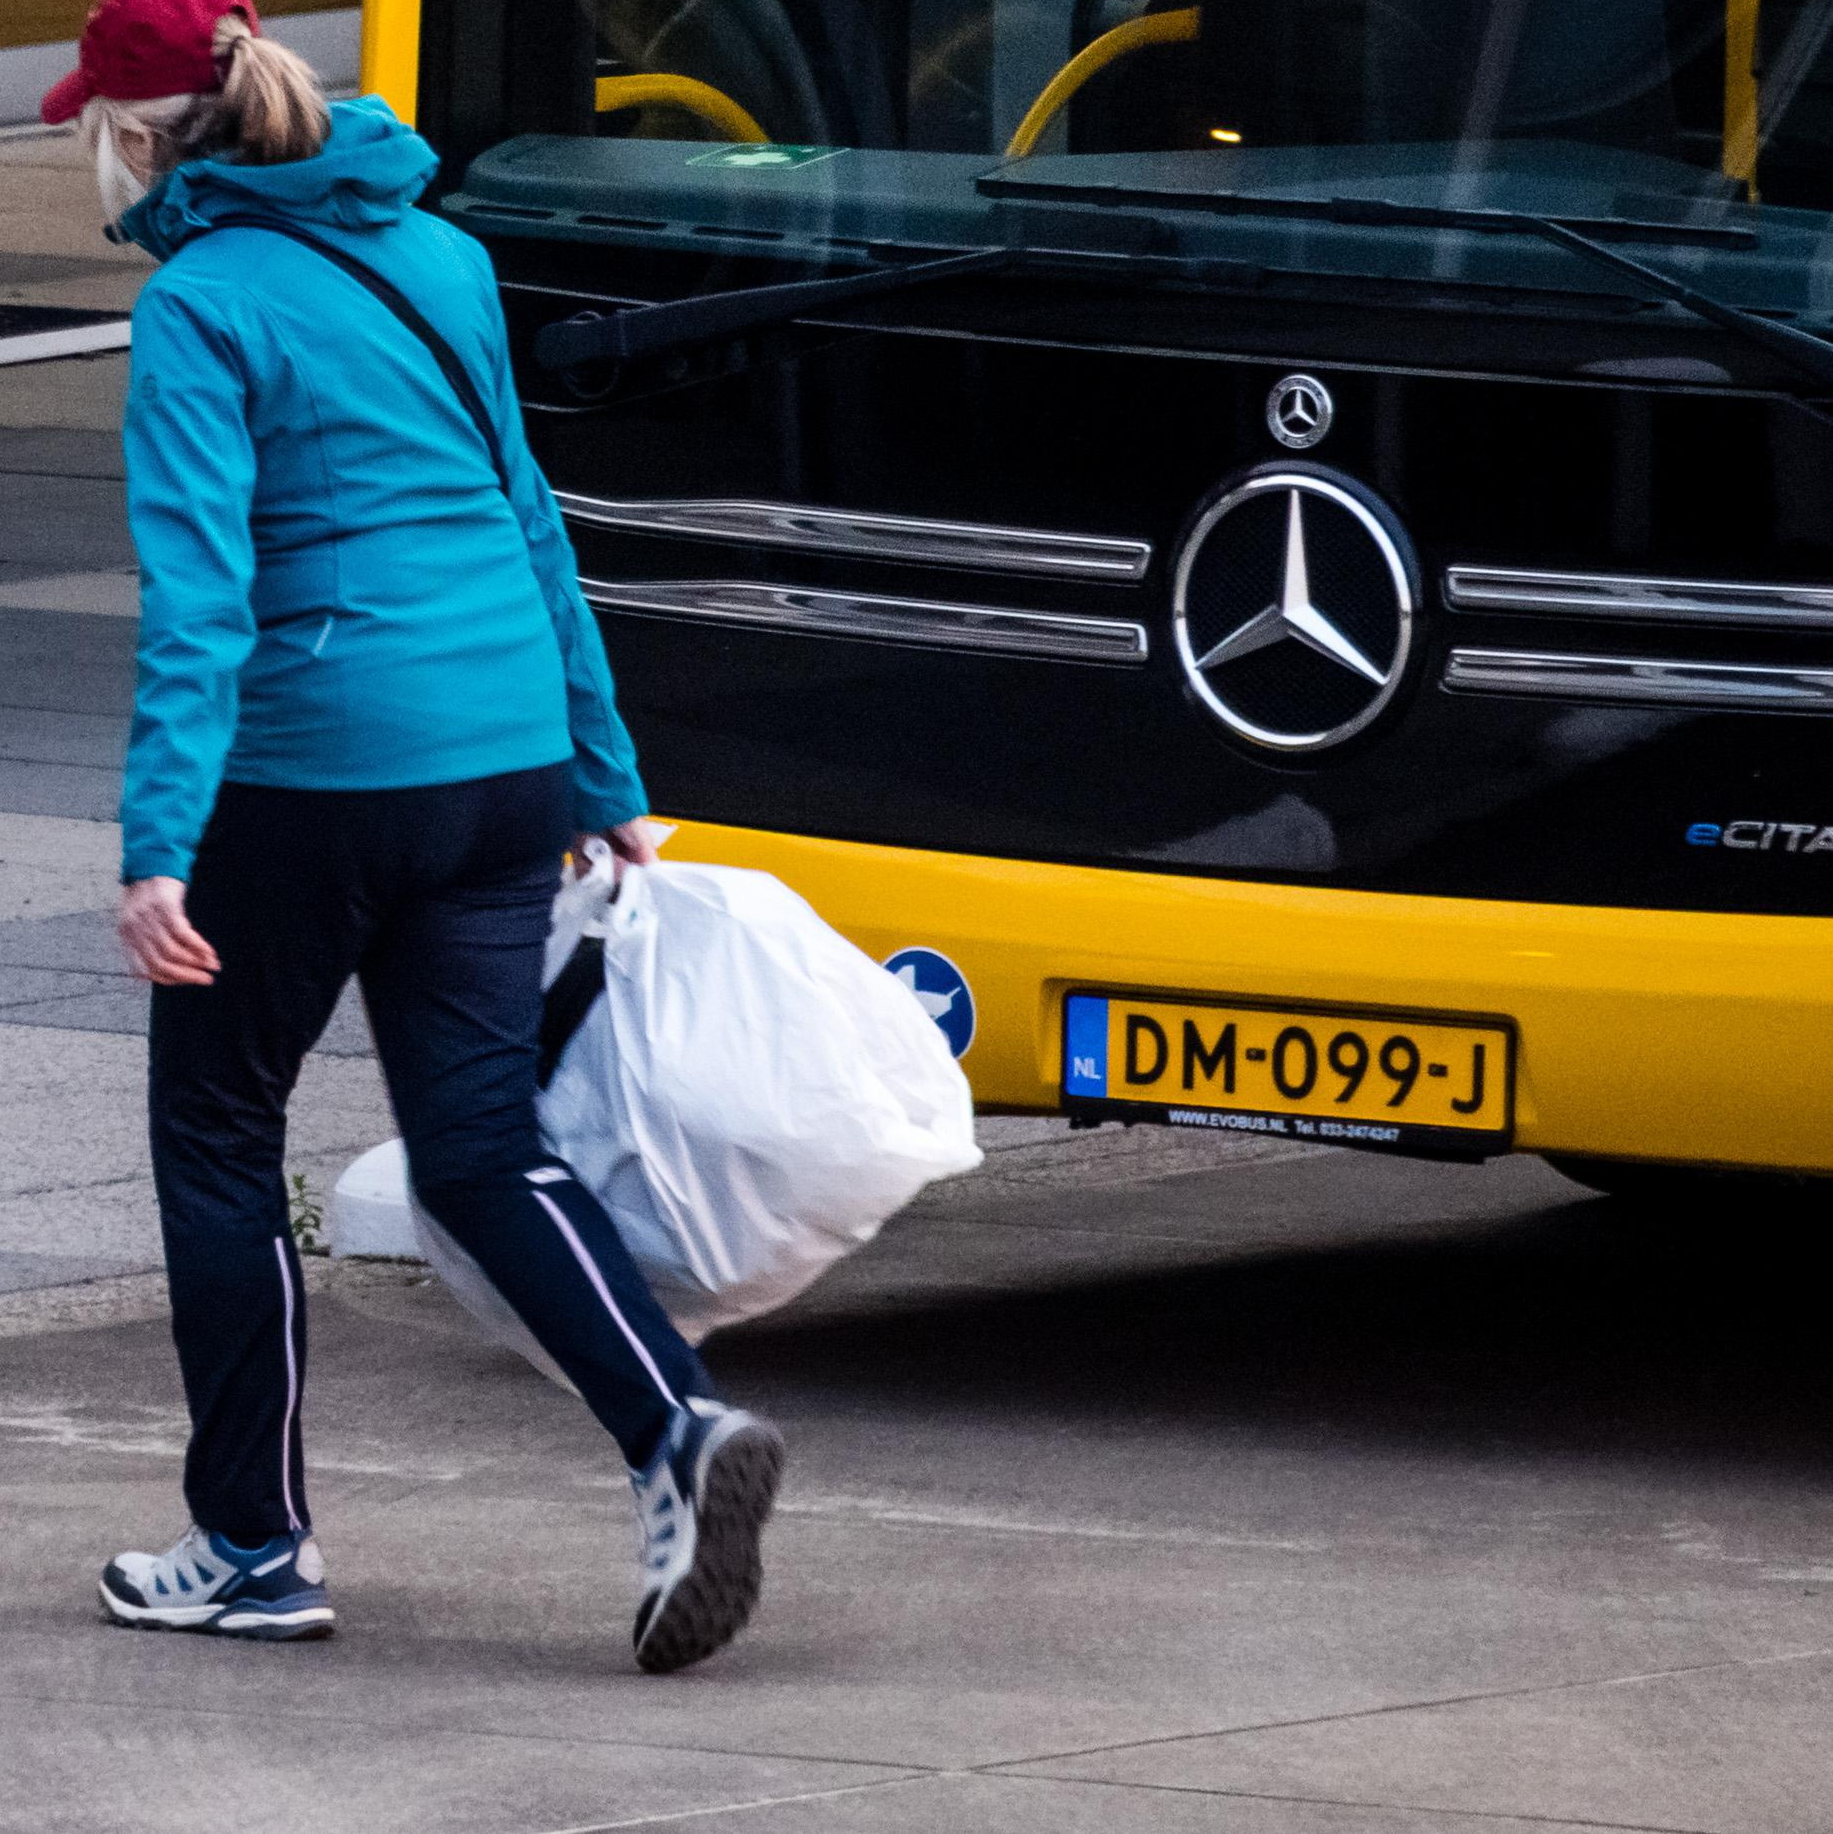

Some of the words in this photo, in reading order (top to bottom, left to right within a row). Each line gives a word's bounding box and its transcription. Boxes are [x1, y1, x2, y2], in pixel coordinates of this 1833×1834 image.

[1074, 1056, 1101, 1080] NL
[1124, 1013, 1486, 1115] DM-099-J
[1168, 1109, 1288, 1133] WWW.EVOBUS.NL
